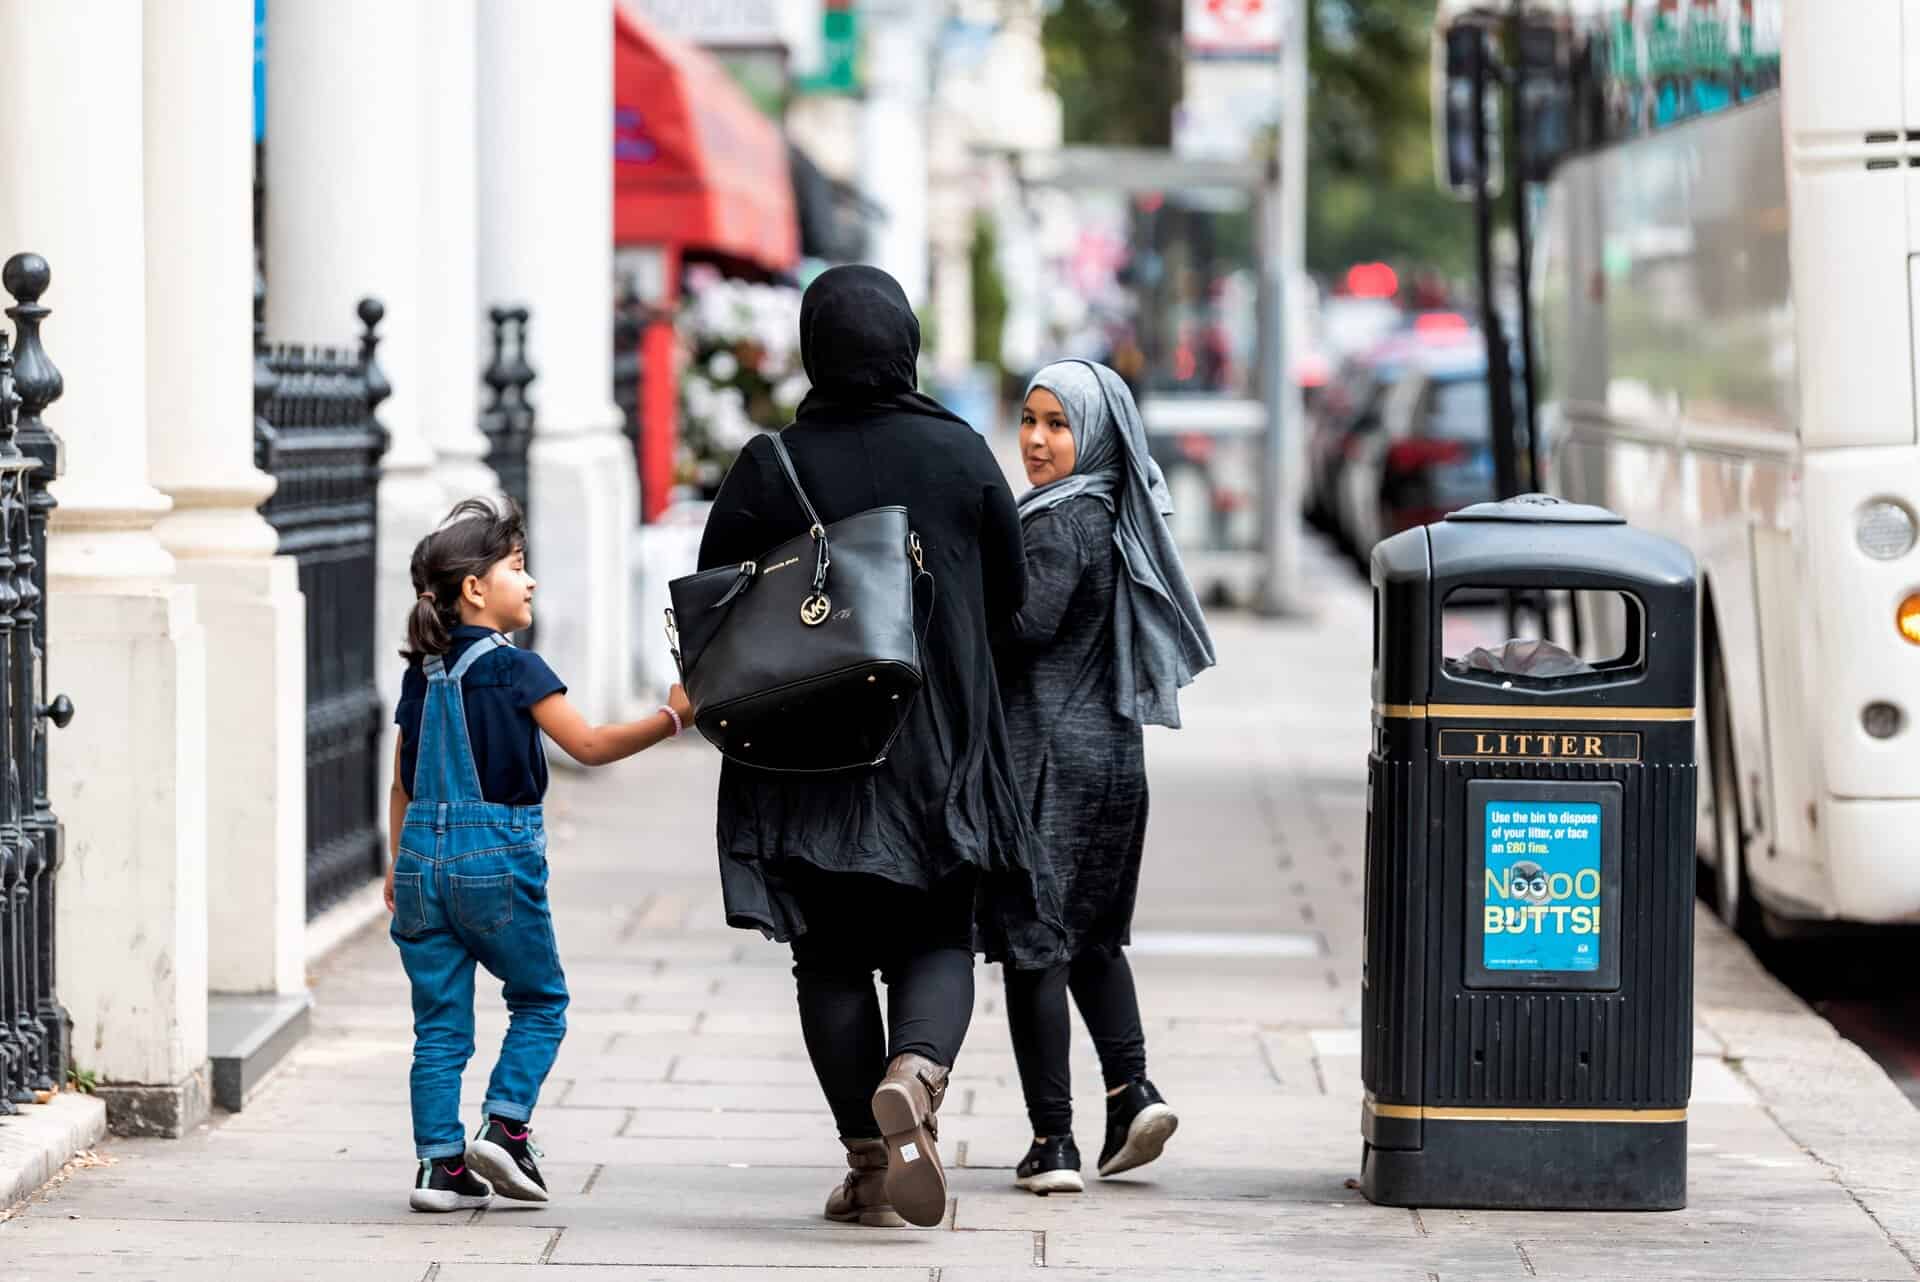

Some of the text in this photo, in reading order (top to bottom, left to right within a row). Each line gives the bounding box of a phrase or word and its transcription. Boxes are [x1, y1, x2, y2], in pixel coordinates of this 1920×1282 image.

[1474, 734, 1603, 756] LITTER
[1491, 811, 1598, 826] Use the bin to dispose
[1491, 826, 1589, 842] of your litter, or face
[1491, 842, 1550, 854] an £80 fine.
[1485, 905, 1600, 934] BUTTS!
